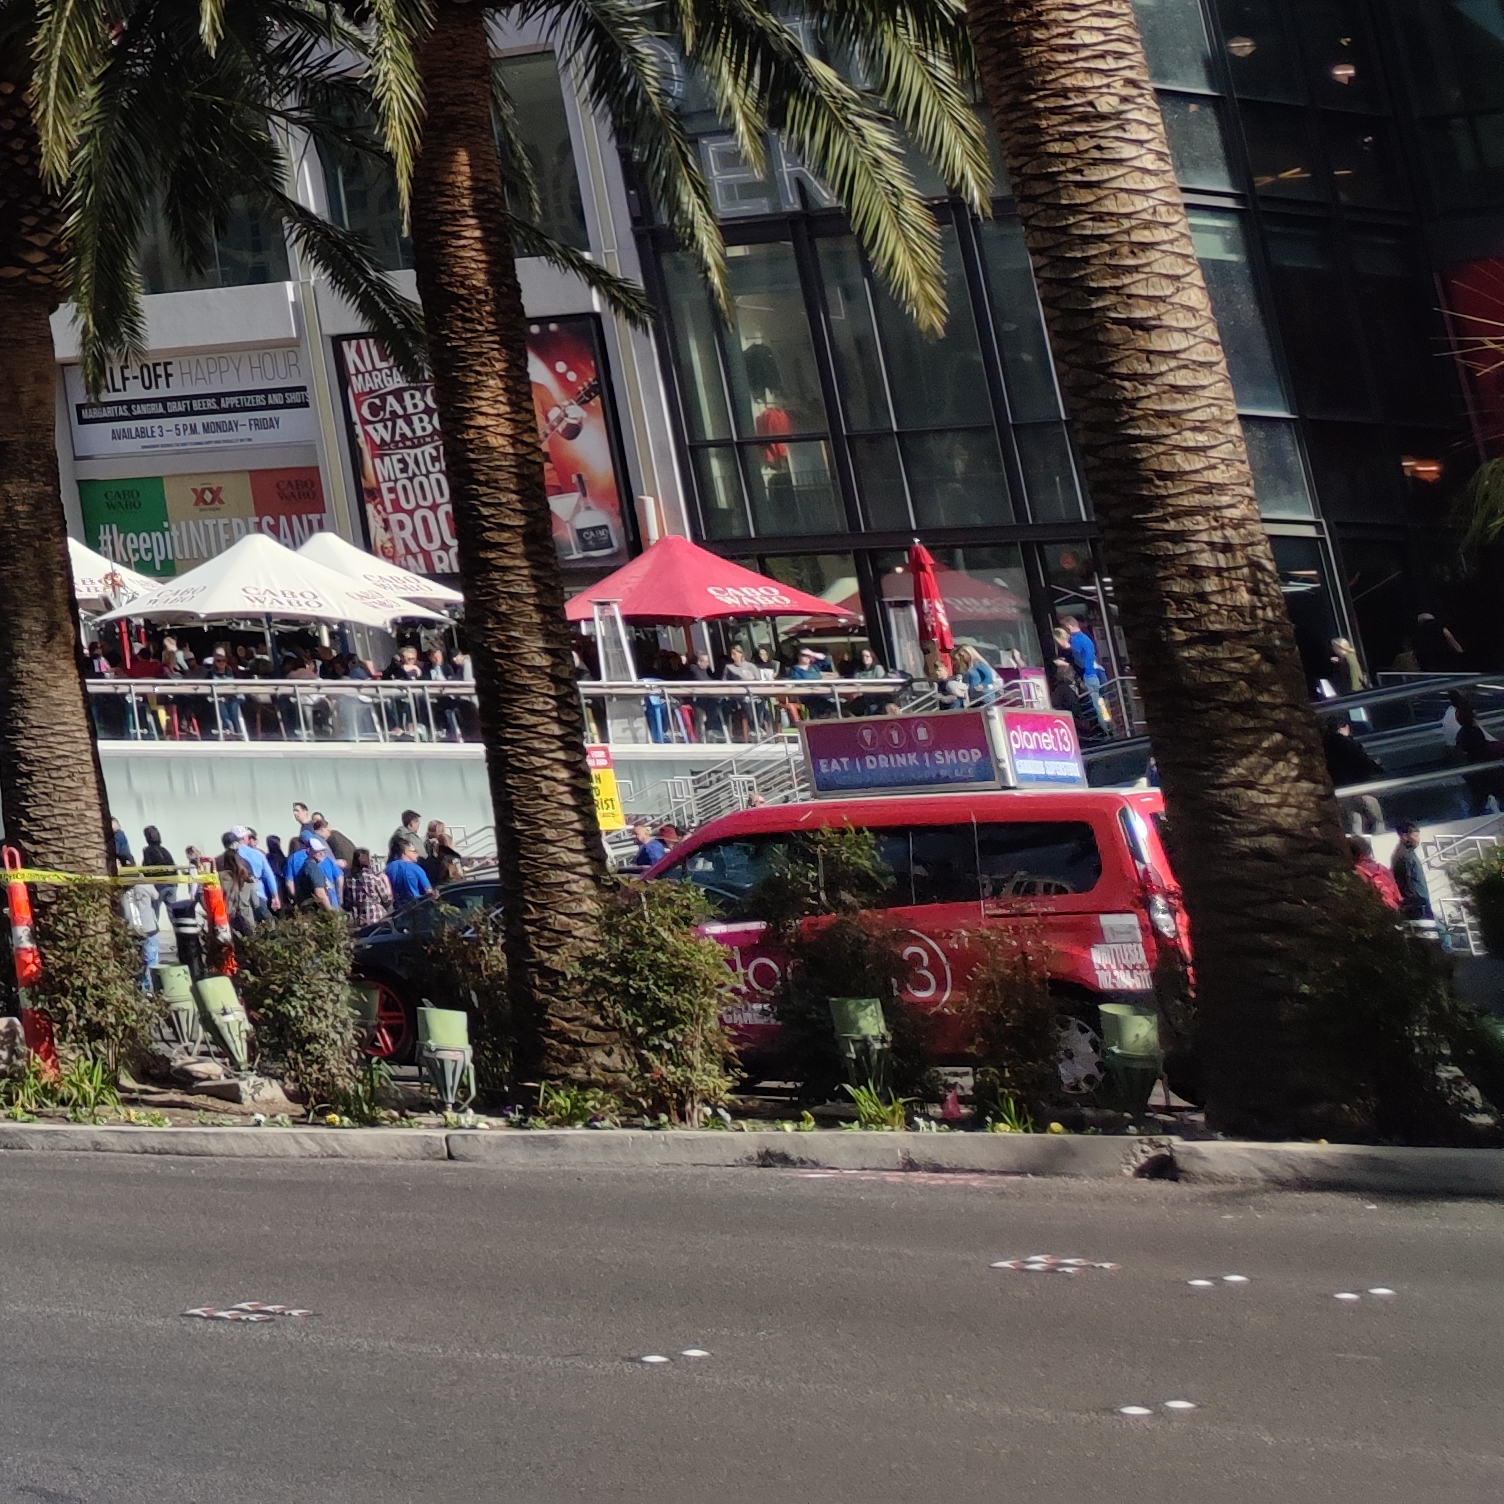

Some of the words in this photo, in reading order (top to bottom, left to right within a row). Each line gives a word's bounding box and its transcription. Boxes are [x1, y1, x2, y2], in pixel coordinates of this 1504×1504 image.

[180, 356, 247, 387] HAPPY
[248, 350, 302, 381] HOUR
[166, 399, 190, 413] DRAFT
[220, 394, 267, 409] APPETIZERS
[268, 394, 285, 405] AND
[285, 391, 310, 404] SHOTS
[111, 424, 157, 441] AVAILABLE
[157, 425, 164, 438] 3
[175, 425, 181, 437] 5
[248, 416, 281, 431] FRIDAY
[241, 585, 320, 600] CABO
[707, 585, 781, 598] CABO
[243, 596, 324, 610] WABO
[820, 756, 849, 774] EAT
[864, 751, 919, 771] DRINK
[934, 748, 982, 765] SHOP
